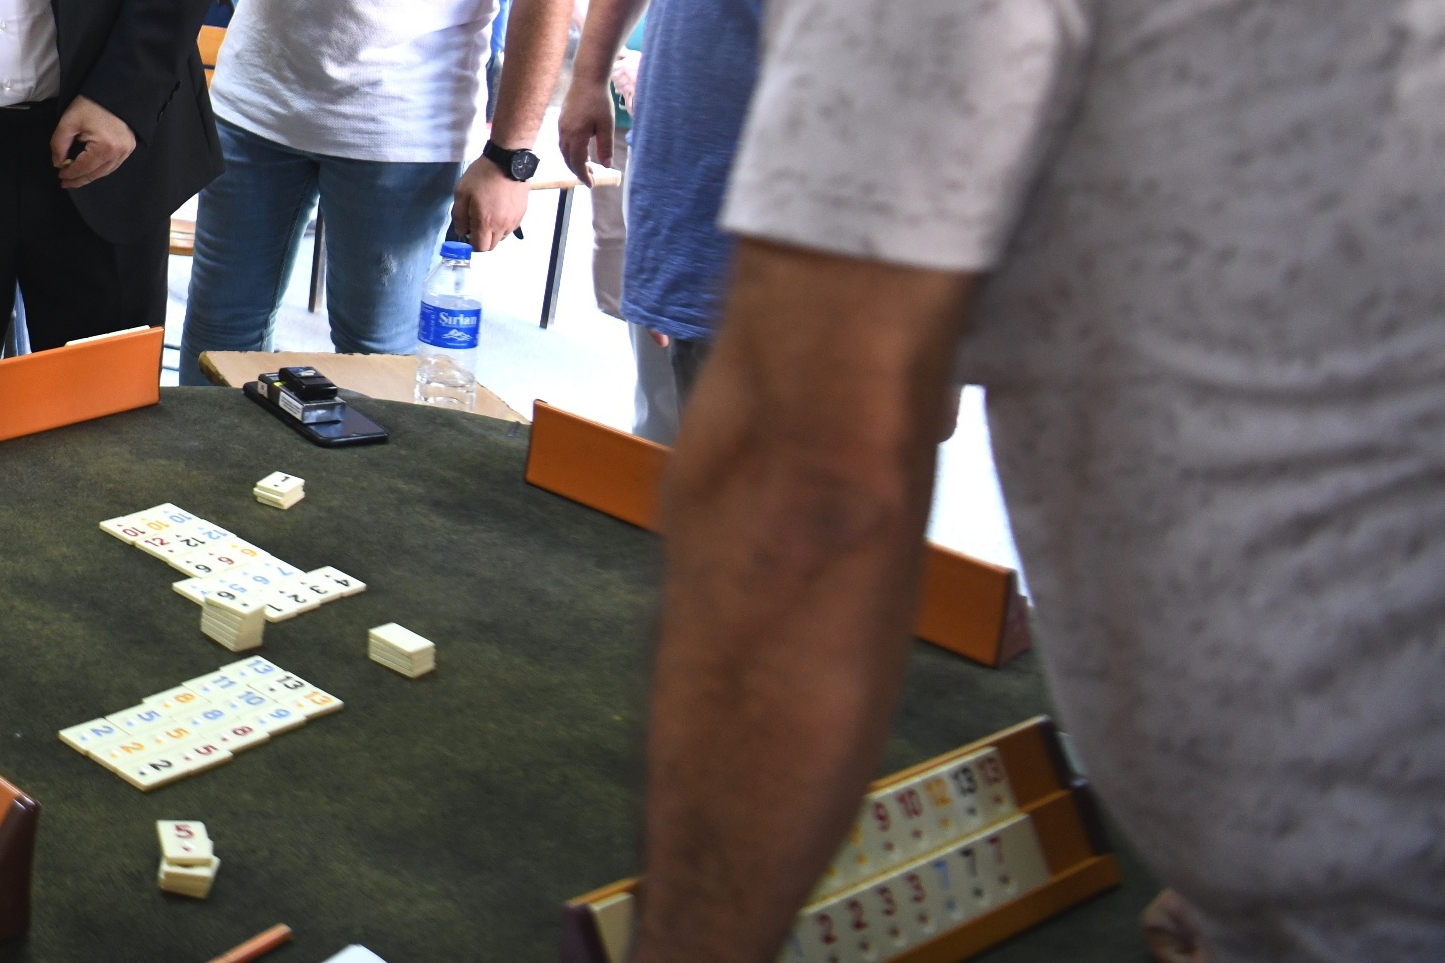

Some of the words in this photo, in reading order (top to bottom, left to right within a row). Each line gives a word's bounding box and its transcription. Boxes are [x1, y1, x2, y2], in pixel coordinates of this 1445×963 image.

[144, 537, 170, 547] 12
[237, 691, 266, 706] 10
[247, 659, 275, 674] 13
[276, 675, 304, 690] 13
[303, 690, 333, 705] 13
[137, 710, 162, 722] 5
[165, 727, 190, 739] 5
[193, 744, 219, 756] 5
[174, 693, 196, 704] 8
[202, 709, 225, 720] 8
[232, 726, 253, 736] 8
[90, 725, 115, 737] 2
[119, 741, 145, 754] 2
[148, 759, 173, 772] 2
